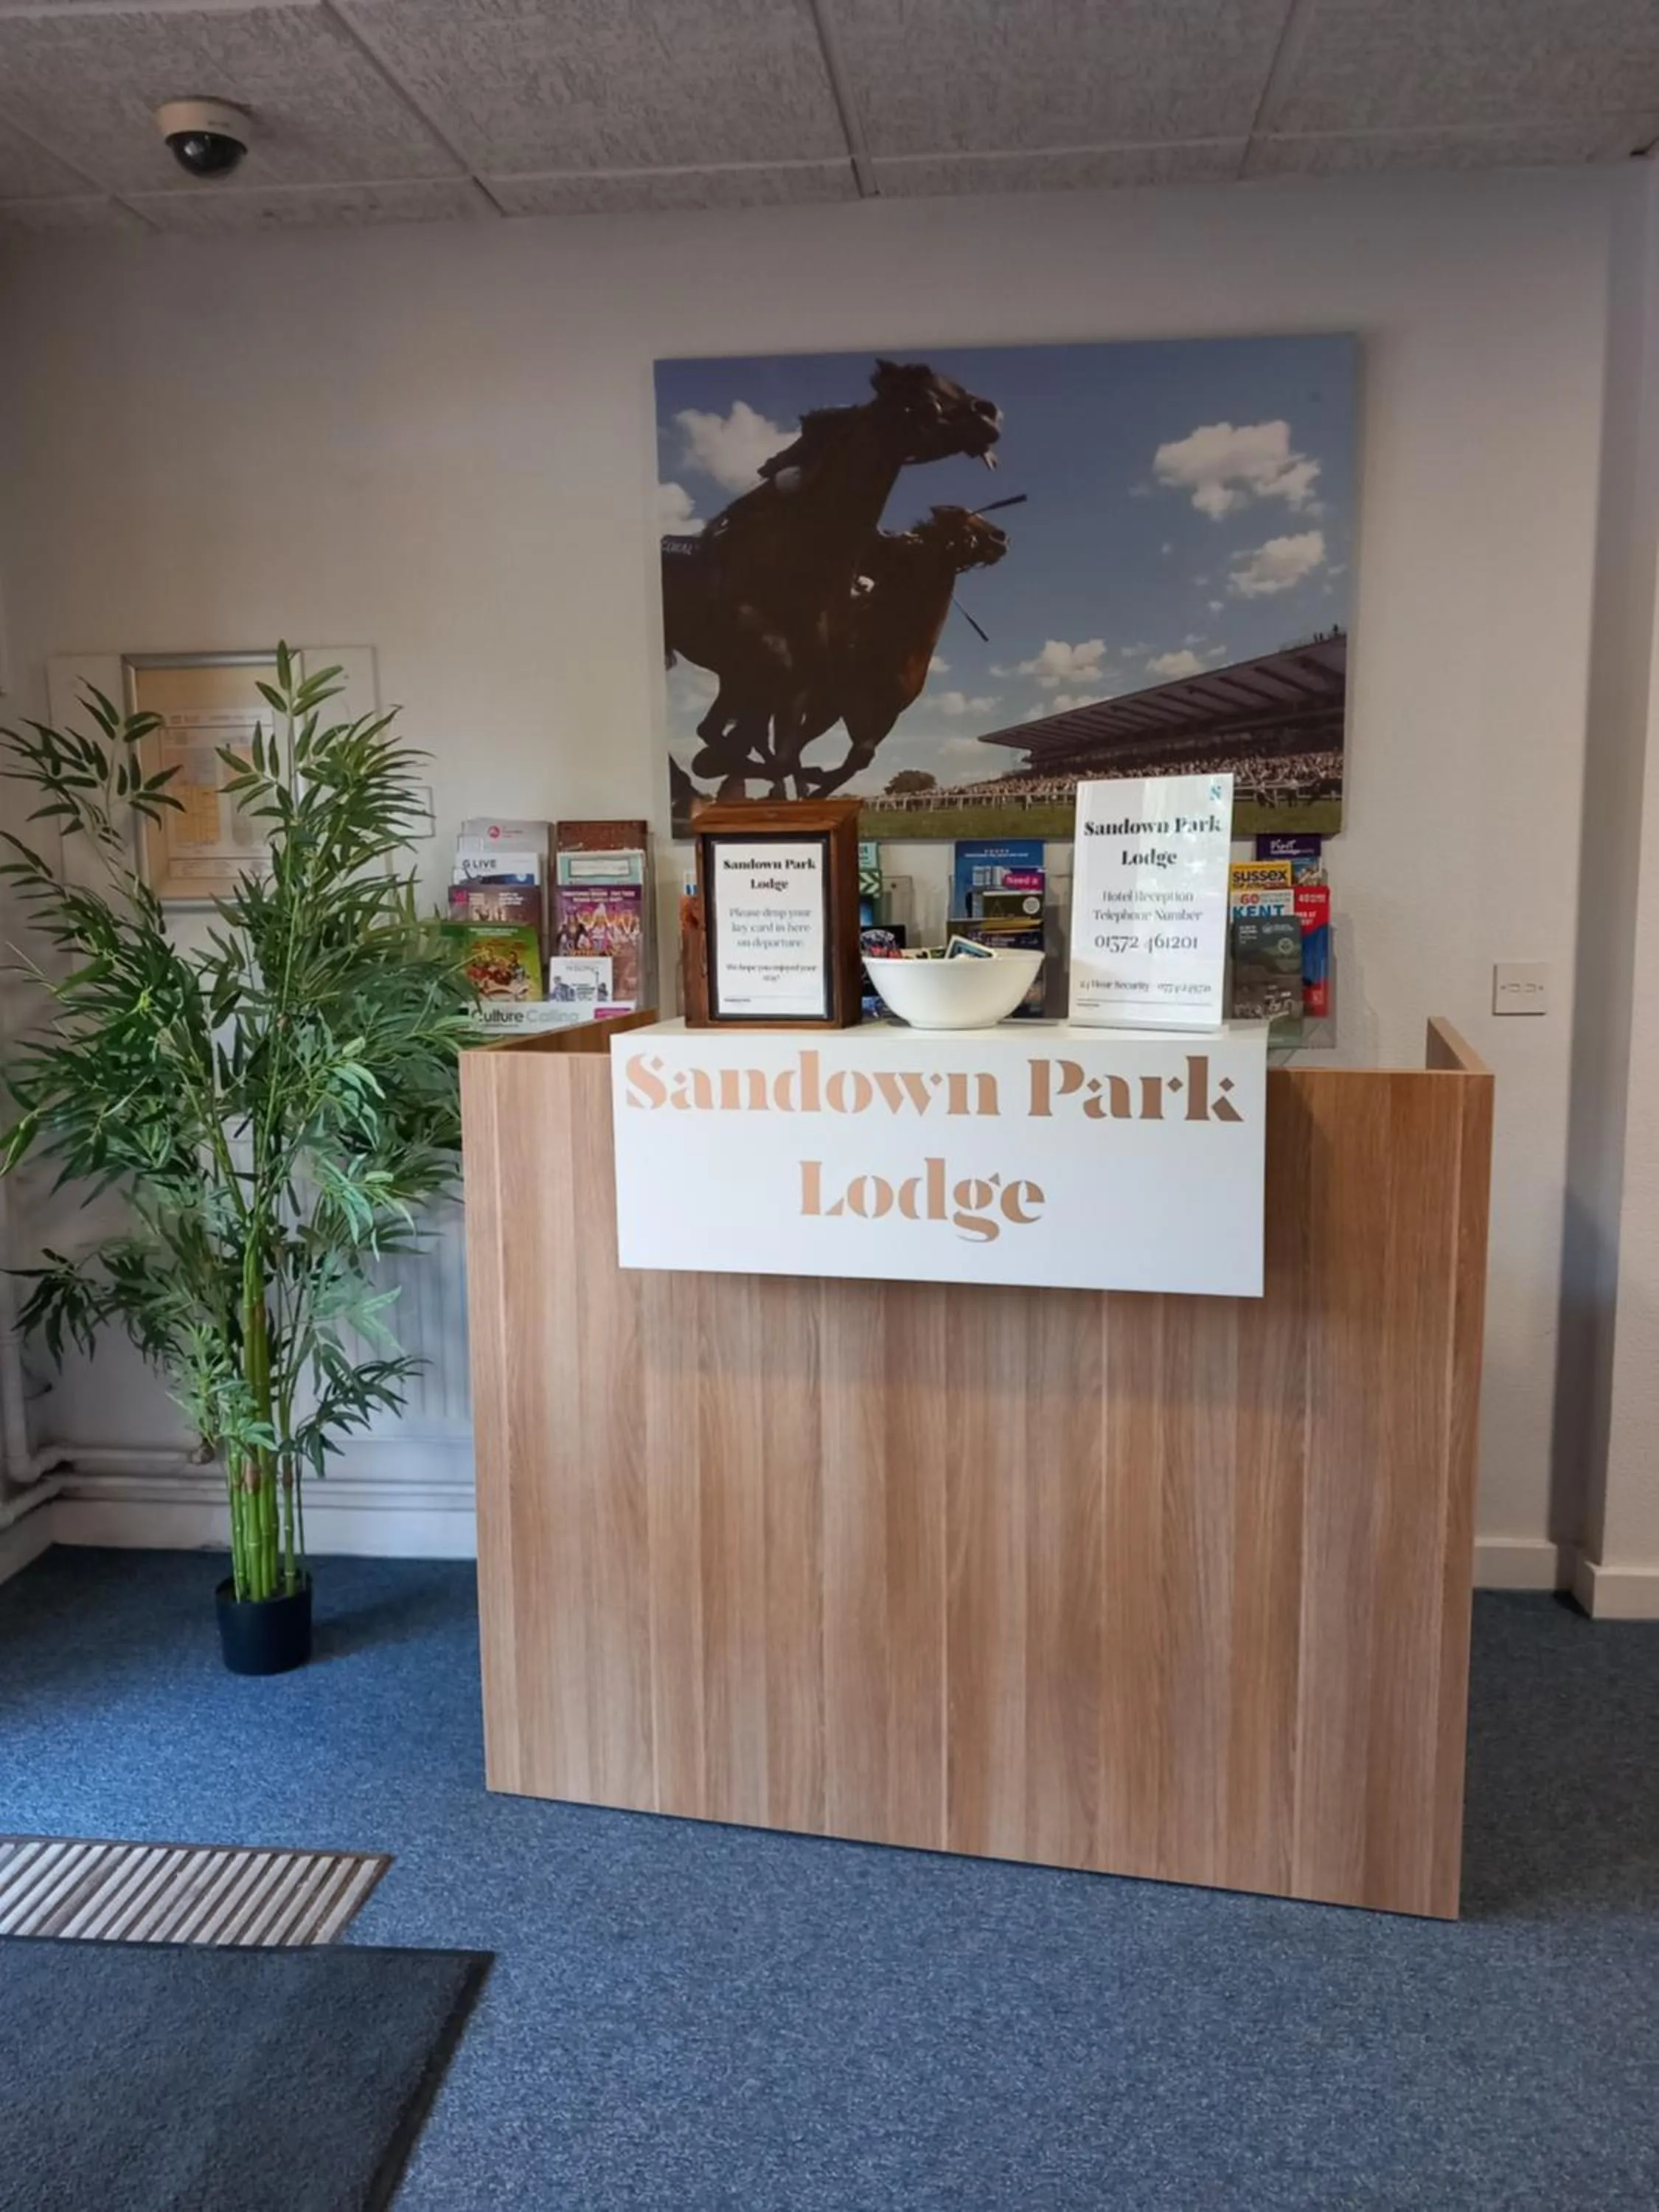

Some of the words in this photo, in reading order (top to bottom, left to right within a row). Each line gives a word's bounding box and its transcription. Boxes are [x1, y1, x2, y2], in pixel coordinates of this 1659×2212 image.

[1083, 817, 1169, 837] Sandown
[1175, 815, 1222, 834] Park
[473, 859, 497, 868] LIVE
[723, 858, 782, 870] Sandown
[785, 858, 816, 870] Park
[1121, 848, 1178, 869] Lodge
[751, 877, 789, 892] Lodge
[1102, 890, 1133, 902] Hotel
[1135, 890, 1194, 905] Reception
[1239, 894, 1260, 905] GO
[728, 907, 760, 918] Please
[762, 907, 787, 920] drop
[788, 909, 812, 920] your
[1093, 908, 1152, 924] Telephone
[1155, 908, 1203, 922] Number
[1233, 905, 1286, 919] KENT
[731, 922, 748, 935] key
[751, 922, 773, 933] card
[775, 922, 785, 933] in
[787, 922, 812, 933] here
[737, 939, 751, 947] on
[1094, 934, 1139, 953] 01572
[1145, 933, 1199, 954] 461201
[472, 1008, 524, 1023] Culture
[625, 1050, 1001, 1117] Sandown
[1027, 1055, 1245, 1122] Park
[798, 1157, 1046, 1244] Lodge
